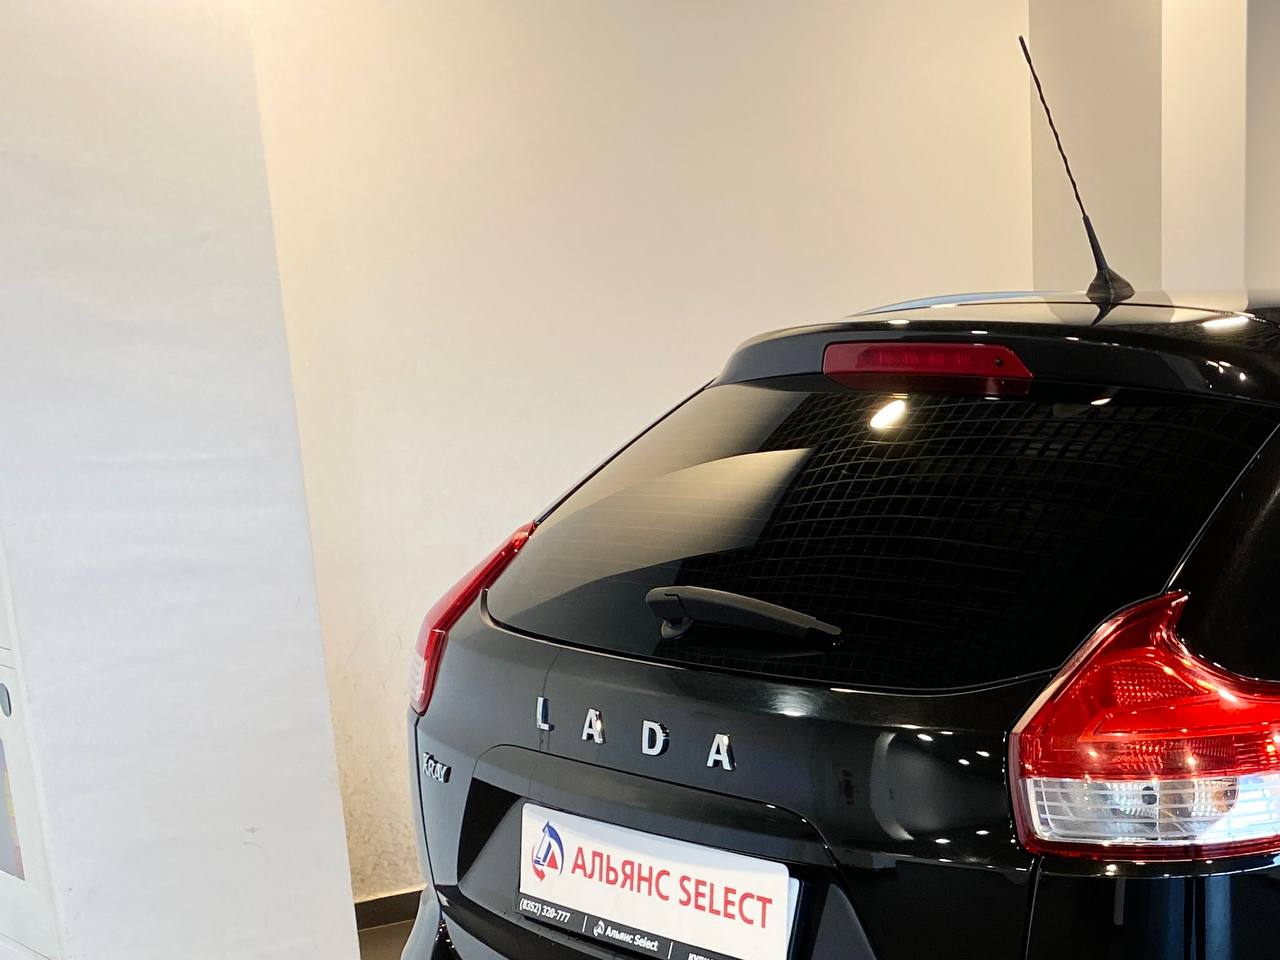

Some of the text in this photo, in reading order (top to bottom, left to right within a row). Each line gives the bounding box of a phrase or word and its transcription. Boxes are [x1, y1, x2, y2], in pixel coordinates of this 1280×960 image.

[536, 696, 736, 771] LADA
[423, 751, 452, 784] XRAY
[571, 846, 773, 928] АЛЬЯНС SELECT
[519, 897, 571, 923] (8352) 320-777
[605, 926, 659, 951] Альянс Select
